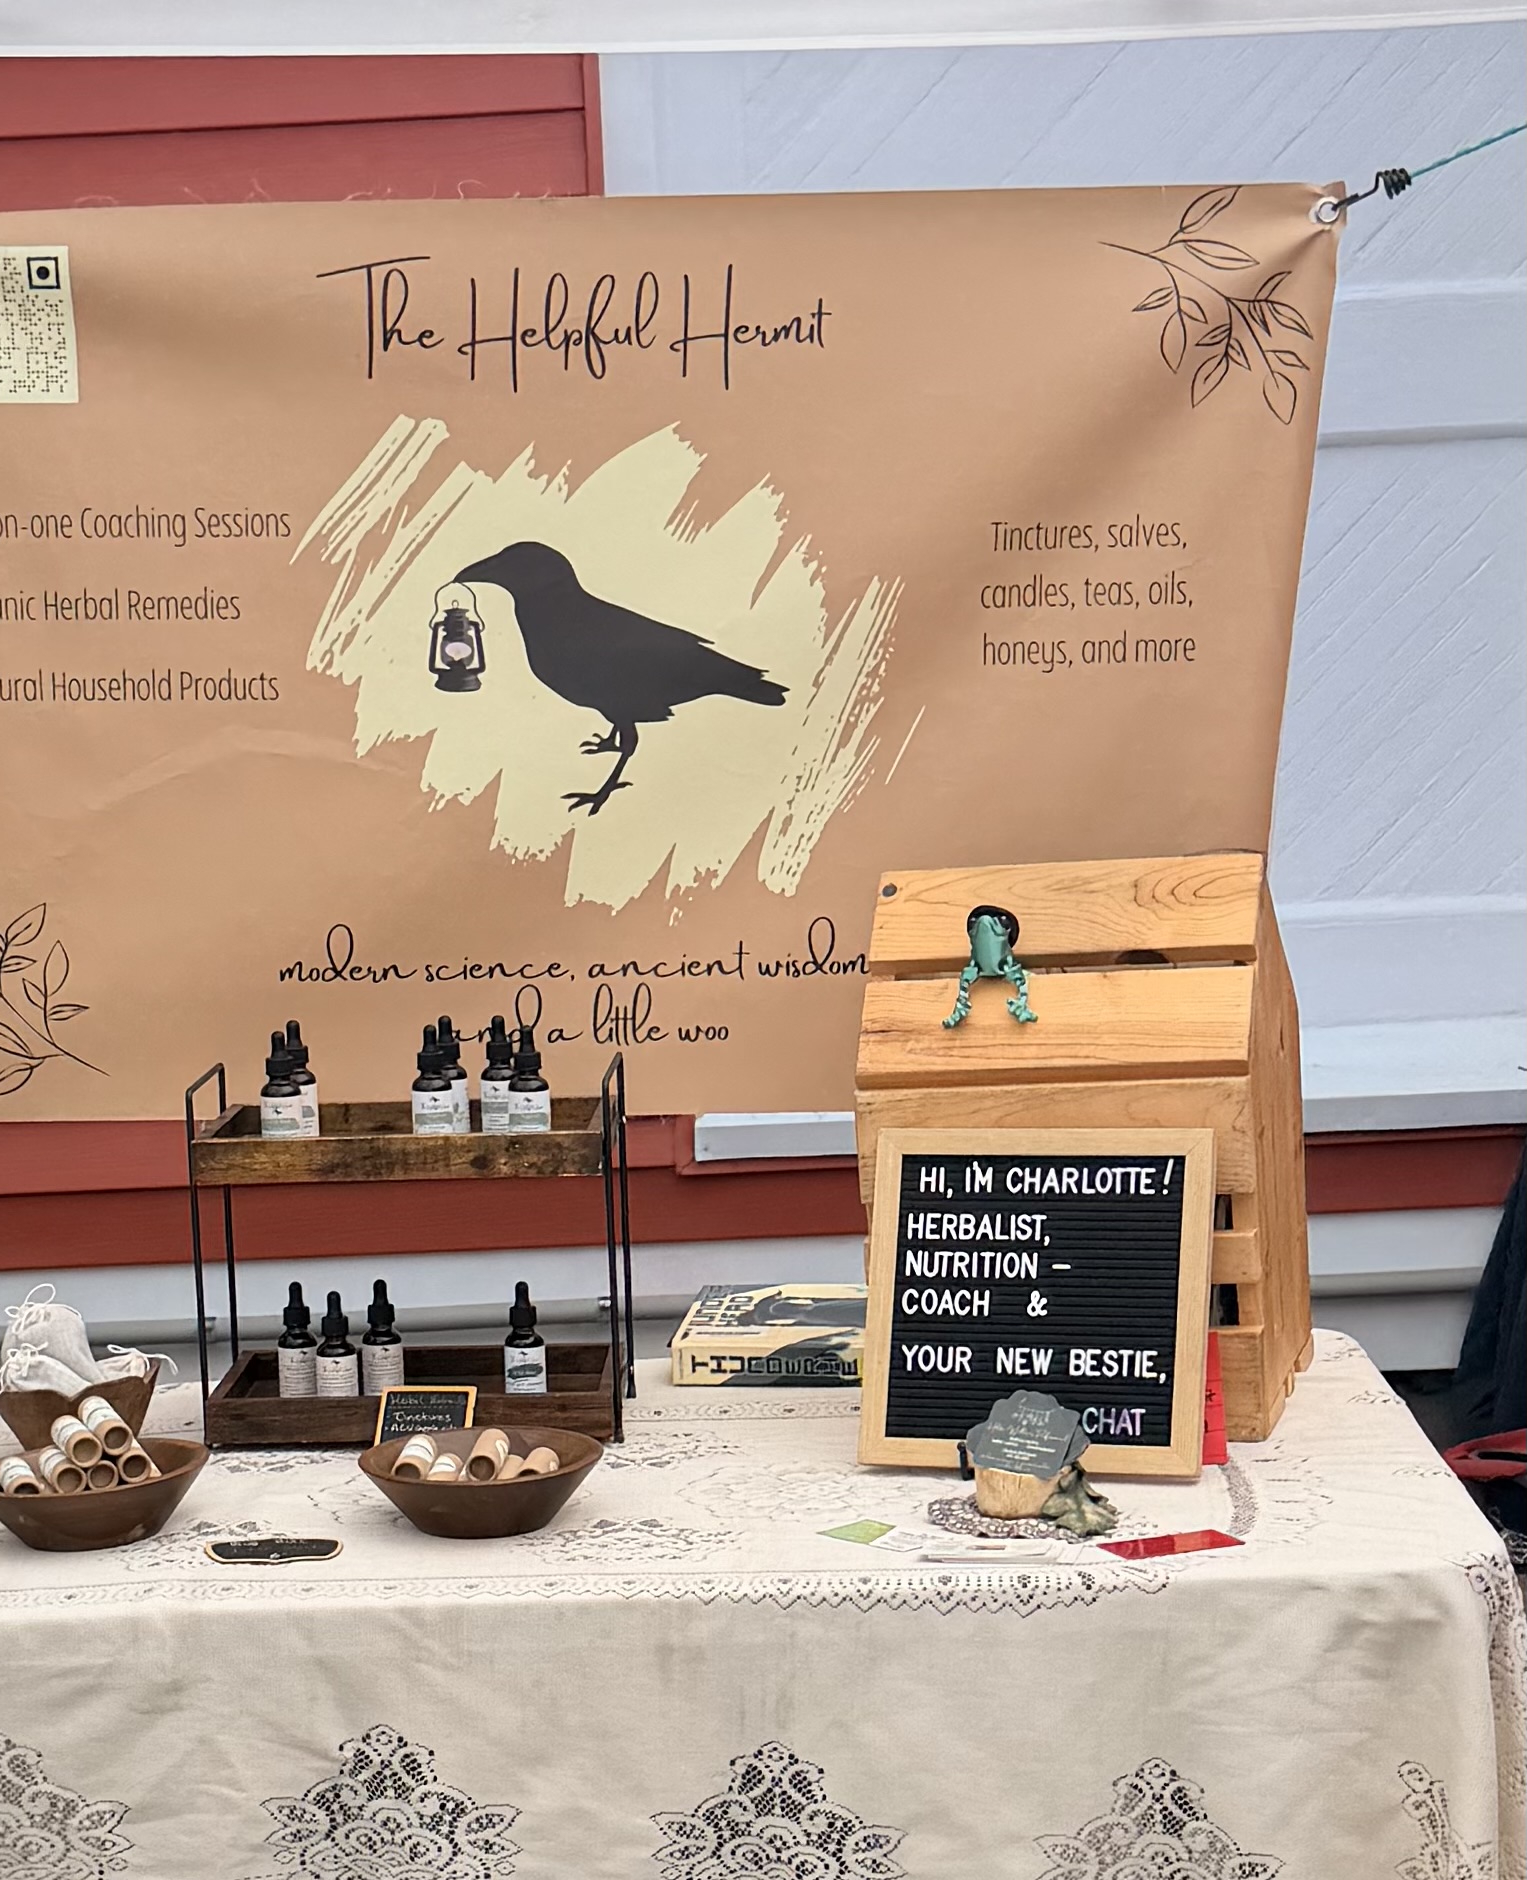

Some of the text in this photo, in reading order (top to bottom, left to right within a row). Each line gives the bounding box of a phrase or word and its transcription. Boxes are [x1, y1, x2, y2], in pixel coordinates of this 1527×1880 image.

[316, 256, 833, 394] The Helpful Hermit
[80, 504, 187, 547] Coaching
[194, 506, 292, 538] Sessions
[990, 513, 1188, 553] Tinctures, salves,
[43, 587, 119, 621] Herbal
[128, 586, 241, 620] Remedies
[980, 570, 1193, 611] candles, teas, oils,
[982, 629, 1196, 674] honeys, and more
[51, 668, 172, 702] Household
[180, 667, 280, 701] Products
[279, 916, 870, 984] modern science, ancient wisdom
[547, 1027, 584, 1044] a
[592, 982, 670, 1046] little
[677, 1024, 729, 1042] woo
[919, 1166, 953, 1199] HI,
[906, 1212, 1051, 1247] HERBALIST,
[904, 1250, 1039, 1280] NUTRITION
[901, 1288, 1048, 1318] COACH &
[690, 1352, 860, 1377] THUNDERHE
[901, 1344, 1168, 1385] YOUR NEW BESTIE,
[1081, 1407, 1147, 1438] CHAT
